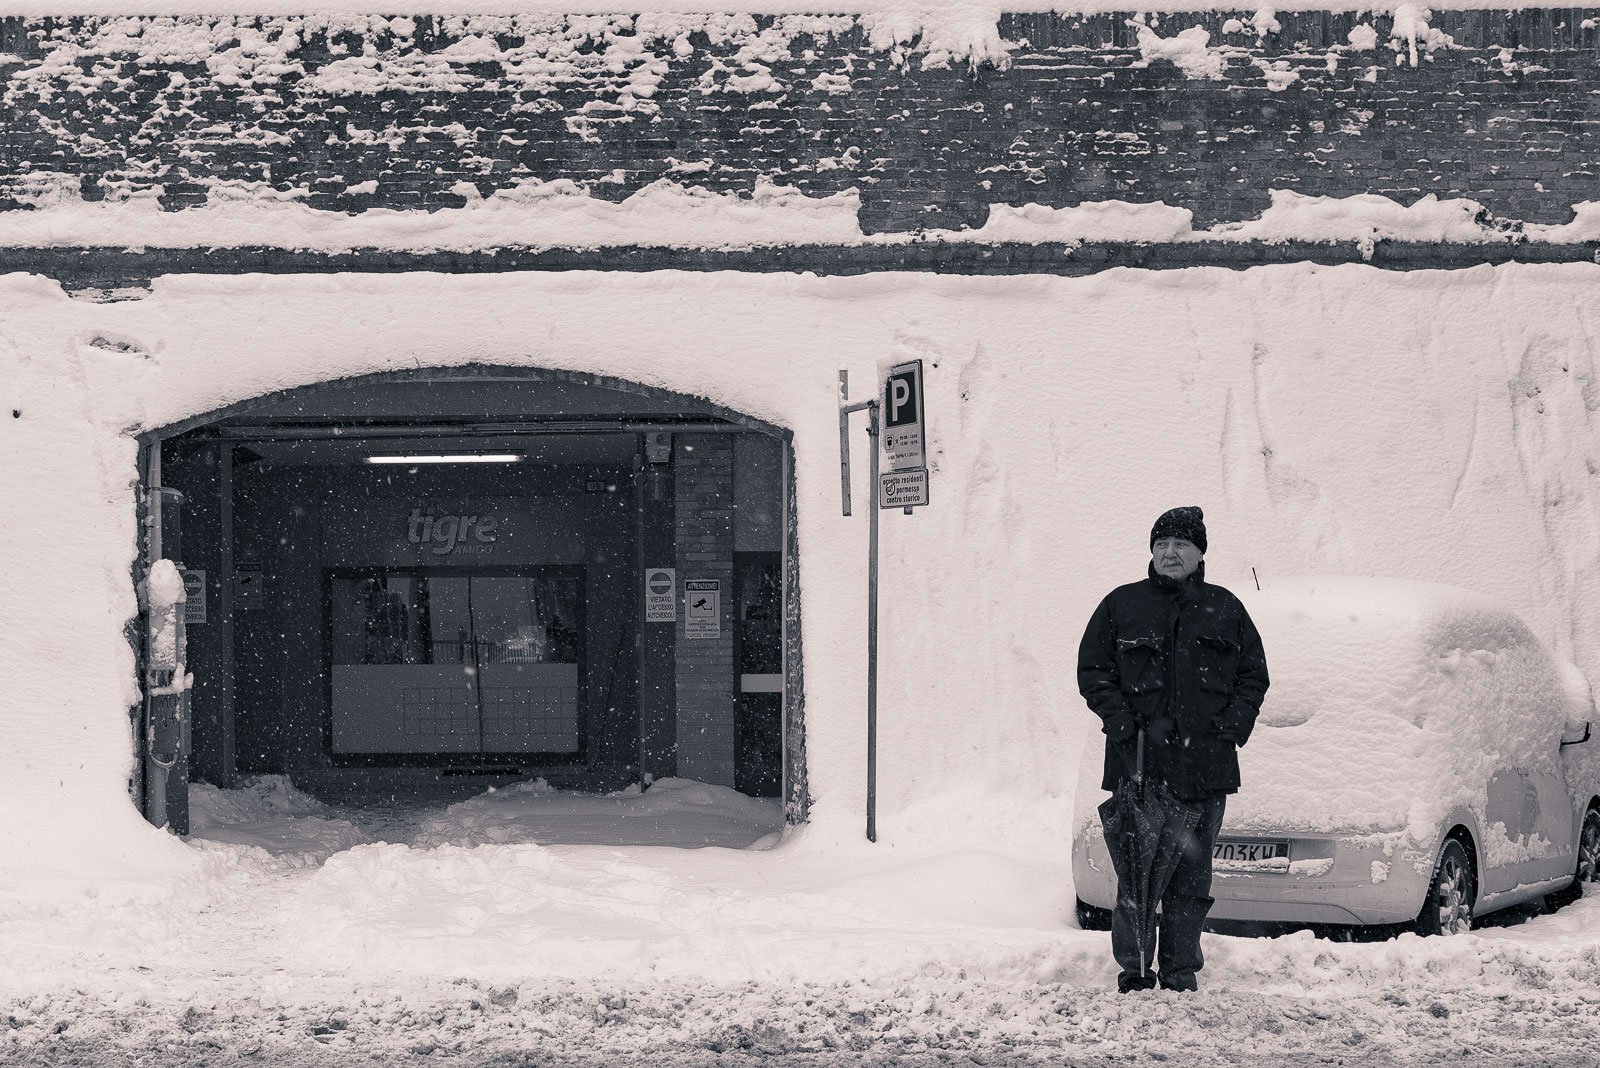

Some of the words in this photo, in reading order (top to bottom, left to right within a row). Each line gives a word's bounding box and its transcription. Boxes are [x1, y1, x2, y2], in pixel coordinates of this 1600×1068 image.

[892, 379, 909, 421] P
[901, 474, 924, 483] residenti
[896, 486, 920, 495] permesso
[887, 496, 902, 504] centro
[903, 494, 920, 502] storico
[407, 507, 499, 555] tigre
[454, 544, 494, 555] AMICO
